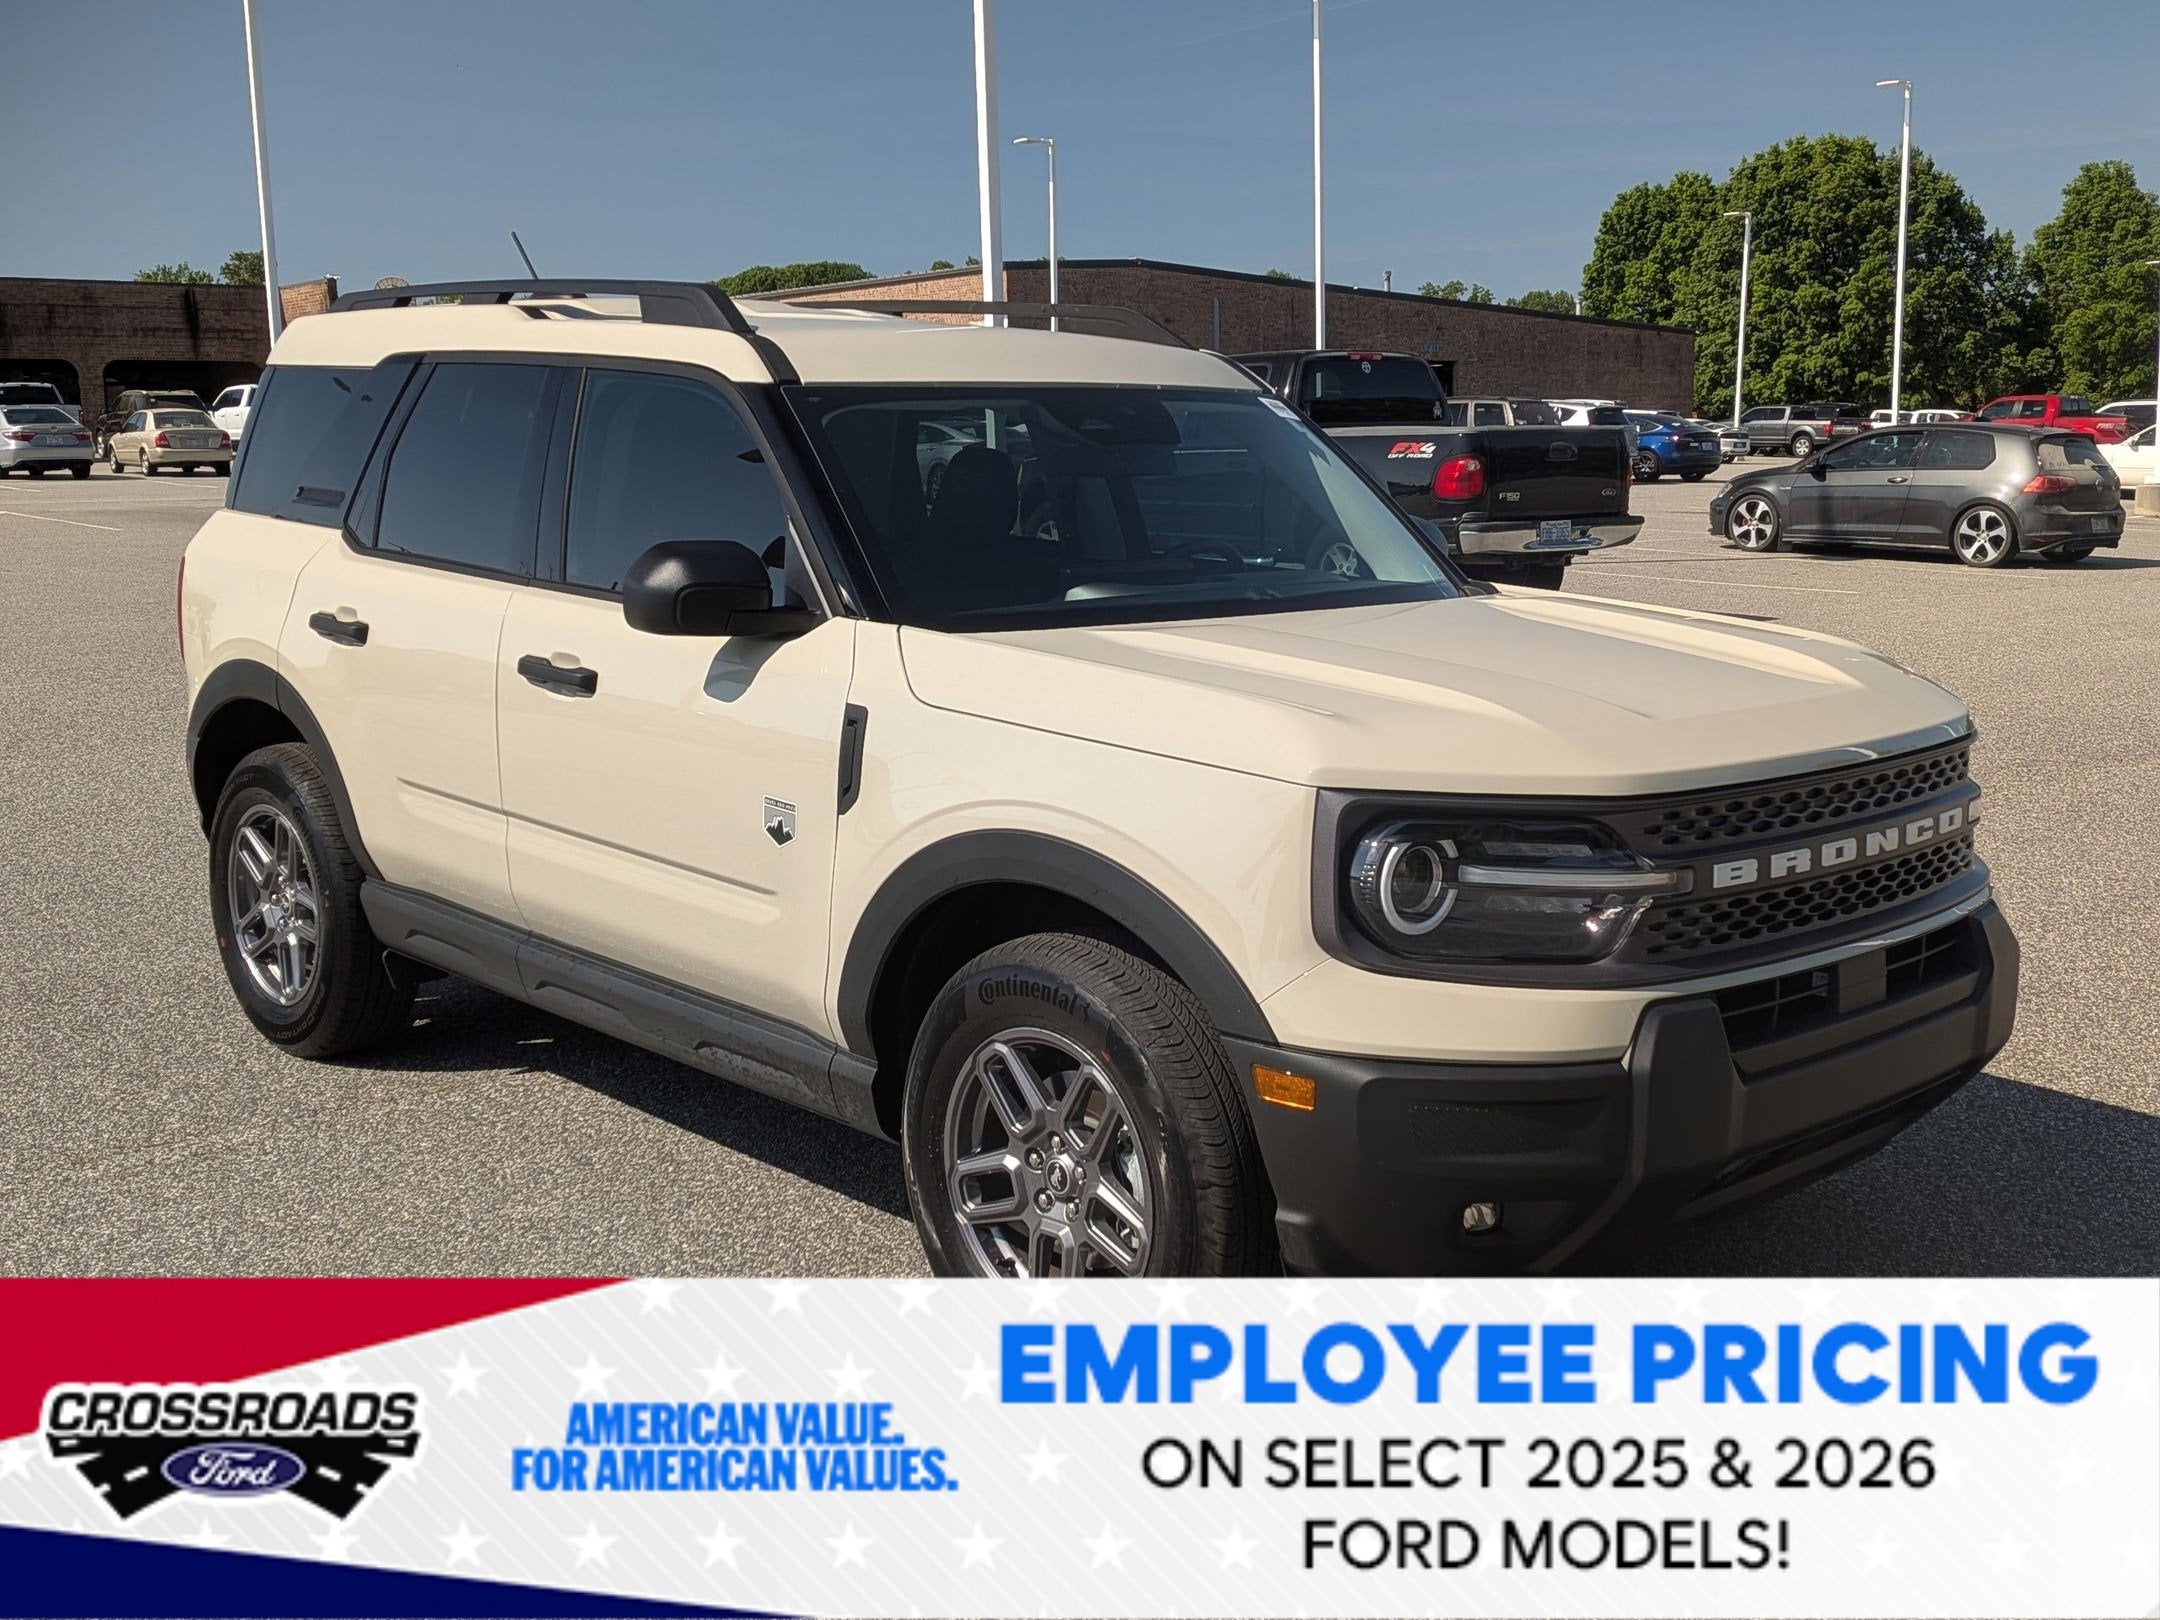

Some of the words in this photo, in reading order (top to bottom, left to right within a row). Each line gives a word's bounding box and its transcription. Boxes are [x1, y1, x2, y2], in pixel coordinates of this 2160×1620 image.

[1390, 442, 1437, 454] FX4
[1499, 491, 1520, 500] F150
[1713, 807, 1963, 889] BRONCO
[978, 974, 1079, 1016] Continental
